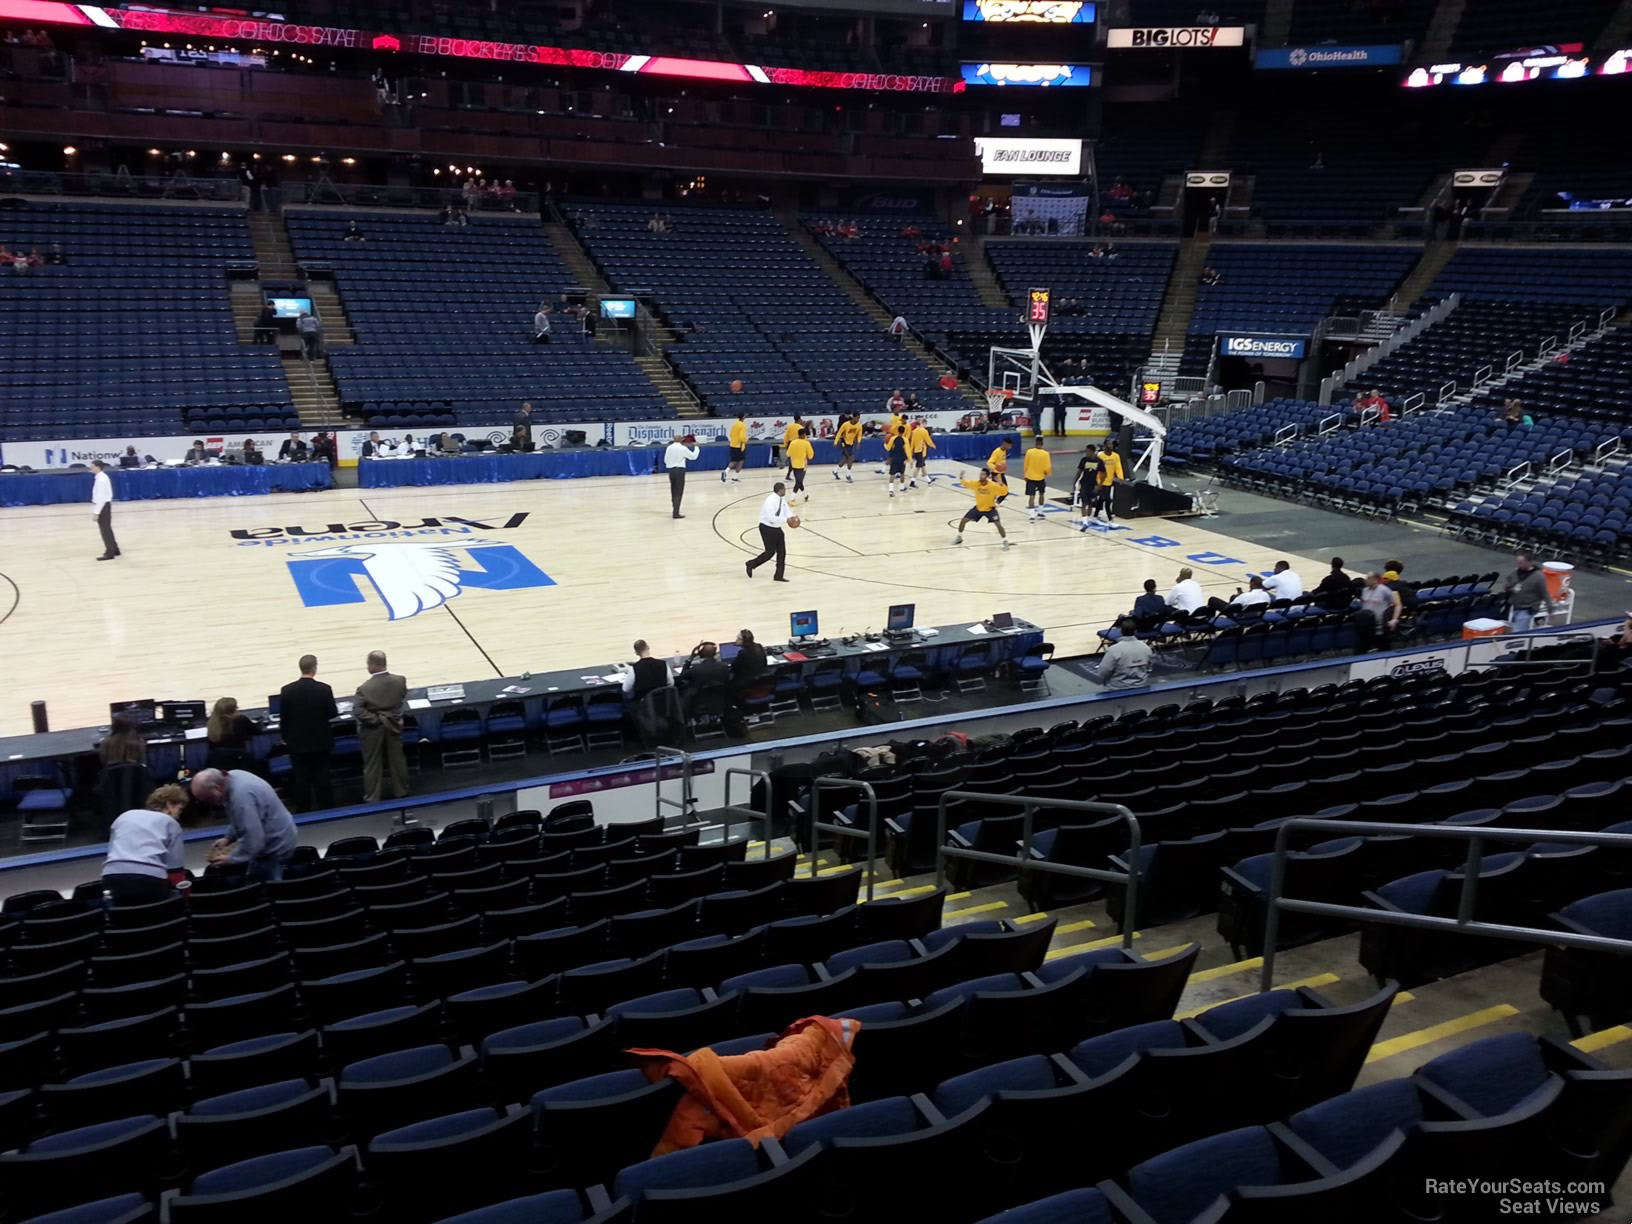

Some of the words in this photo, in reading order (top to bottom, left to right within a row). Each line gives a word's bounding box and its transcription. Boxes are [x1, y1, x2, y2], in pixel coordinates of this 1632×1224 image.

[1132, 29, 1168, 46] BIG
[1308, 50, 1368, 61] OhioHealth
[993, 150, 1019, 162] FAN
[1020, 150, 1072, 163] LOUNGE
[1031, 302, 1046, 320] 35
[1228, 337, 1253, 351] IGS
[1252, 341, 1297, 353] ENERGY
[628, 426, 675, 442] Dispatch
[71, 451, 121, 461] Nationw
[229, 511, 530, 540] Arena
[237, 527, 472, 547] Nationwide
[1405, 660, 1444, 672] LEXUS
